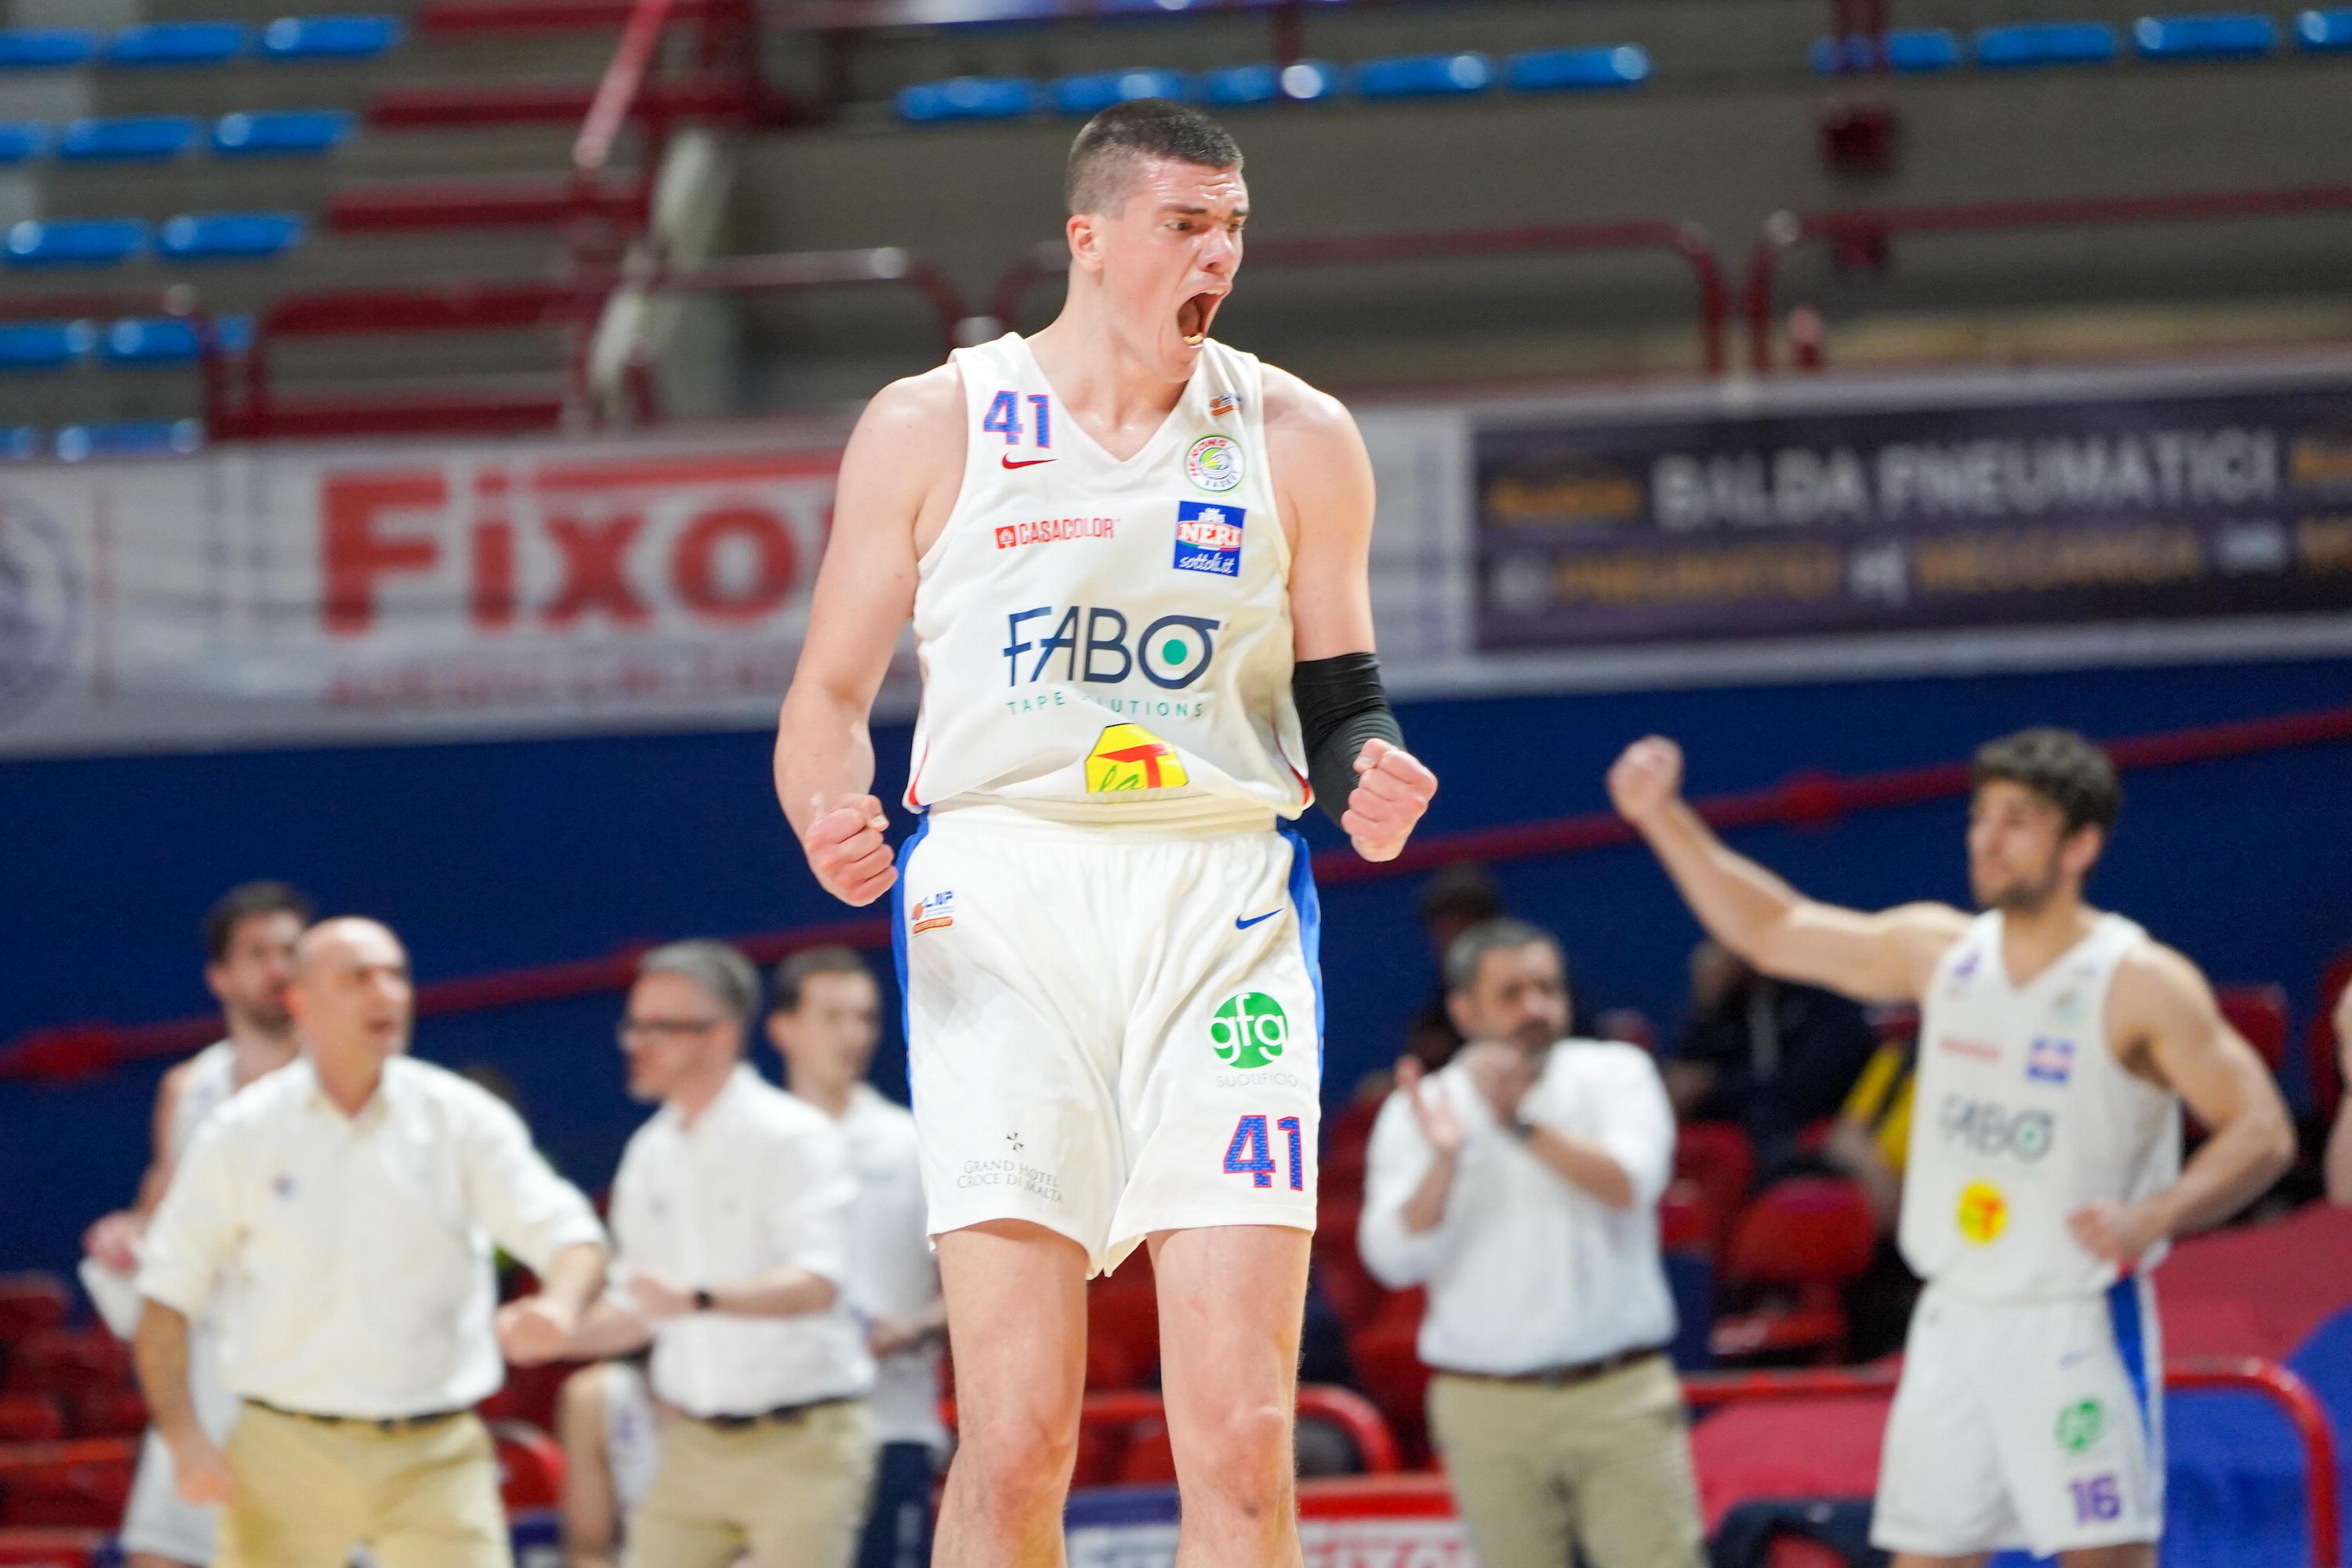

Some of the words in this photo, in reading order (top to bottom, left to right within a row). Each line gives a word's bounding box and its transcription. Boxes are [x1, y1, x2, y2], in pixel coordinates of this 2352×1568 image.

[982, 390, 1051, 448] 41
[321, 470, 834, 637] Fixo
[1019, 517, 1114, 545] CASACOLOR
[1178, 523, 1242, 546] NERI
[1003, 606, 1220, 689] FABO
[1007, 691, 1065, 715] TAPE
[1077, 694, 1203, 717] UTIONS
[1207, 993, 1287, 1065] gfg
[964, 1160, 1014, 1174] GRAND
[1019, 1163, 1058, 1188] HOTEL
[1223, 1114, 1303, 1191] 41
[957, 1174, 1000, 1189] CROCE
[1007, 1174, 1022, 1187] DI
[1025, 1178, 1063, 1203] MALTA
[2067, 1473, 2121, 1525] 16
